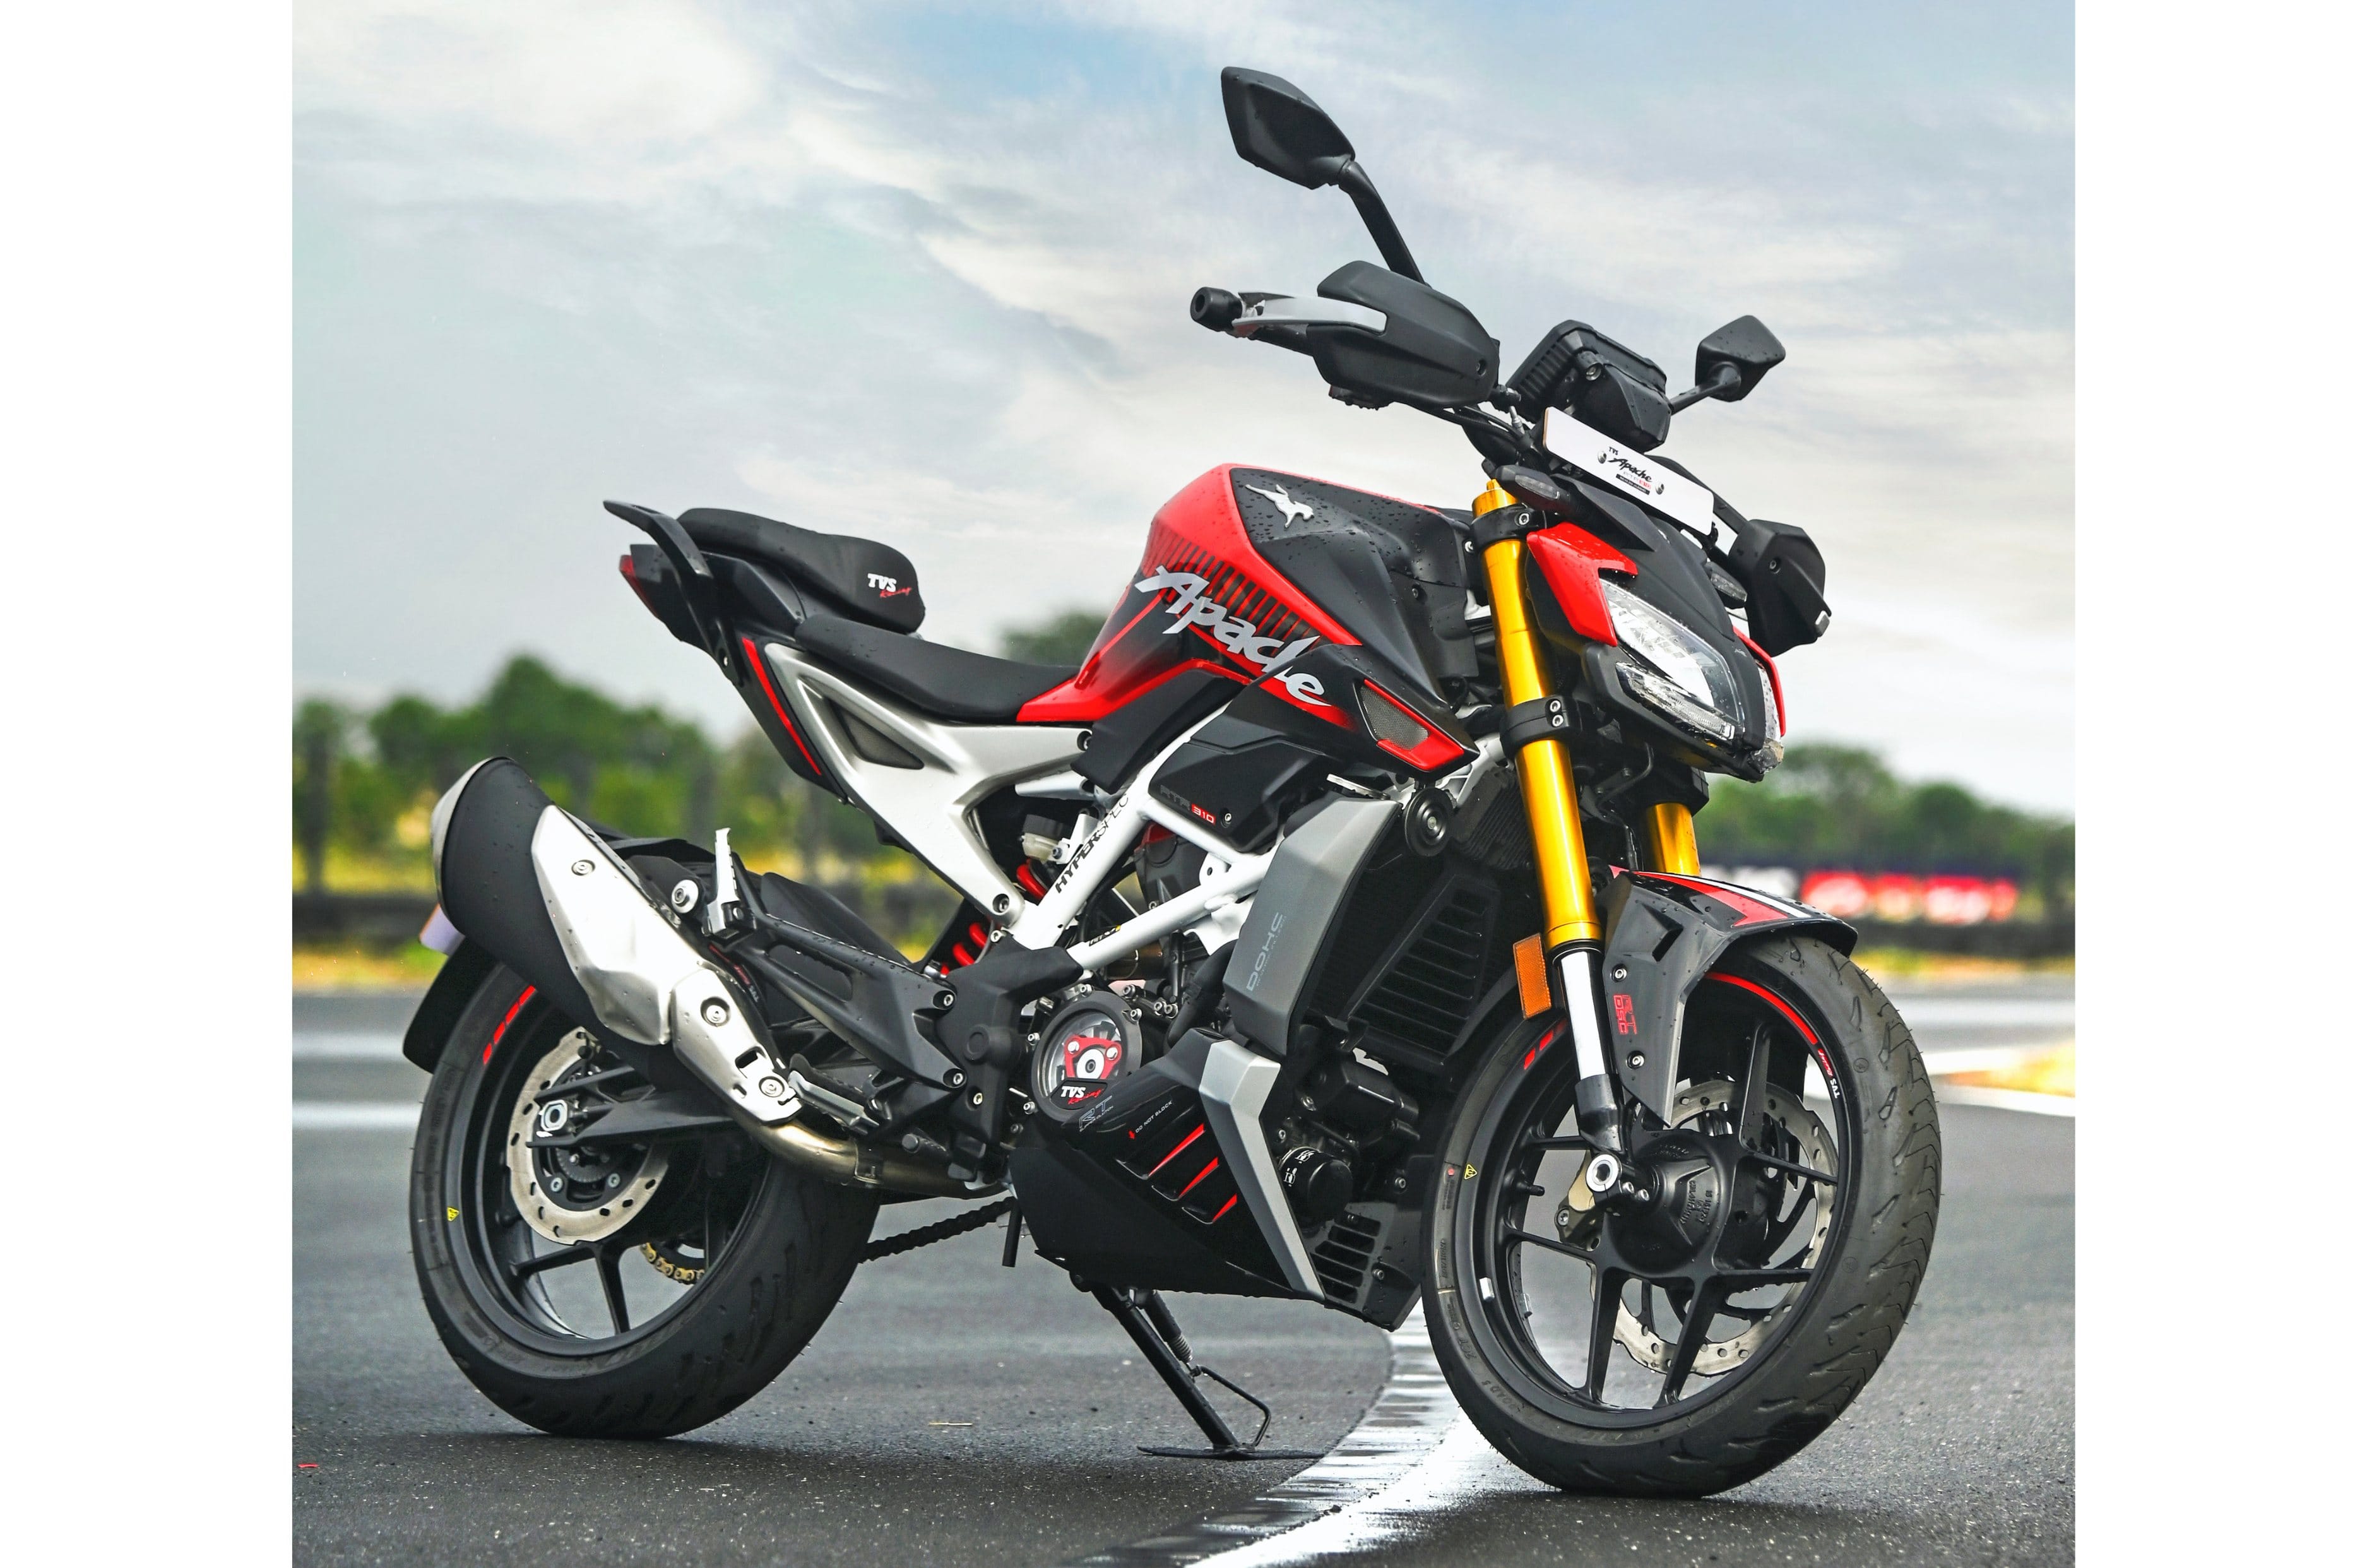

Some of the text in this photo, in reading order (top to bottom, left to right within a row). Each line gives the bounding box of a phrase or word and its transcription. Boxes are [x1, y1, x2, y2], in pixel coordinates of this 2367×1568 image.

[1607, 458, 1652, 482] Apache
[868, 573, 897, 592] TVS
[1134, 565, 1332, 706] Apache
[1194, 805, 1214, 824] 310
[1246, 912, 1283, 991] DOHC
[1061, 1086, 1086, 1098] TVS
[1830, 1078, 1840, 1098] TVS
[1136, 1100, 1172, 1133] DO NOT BLOCK
